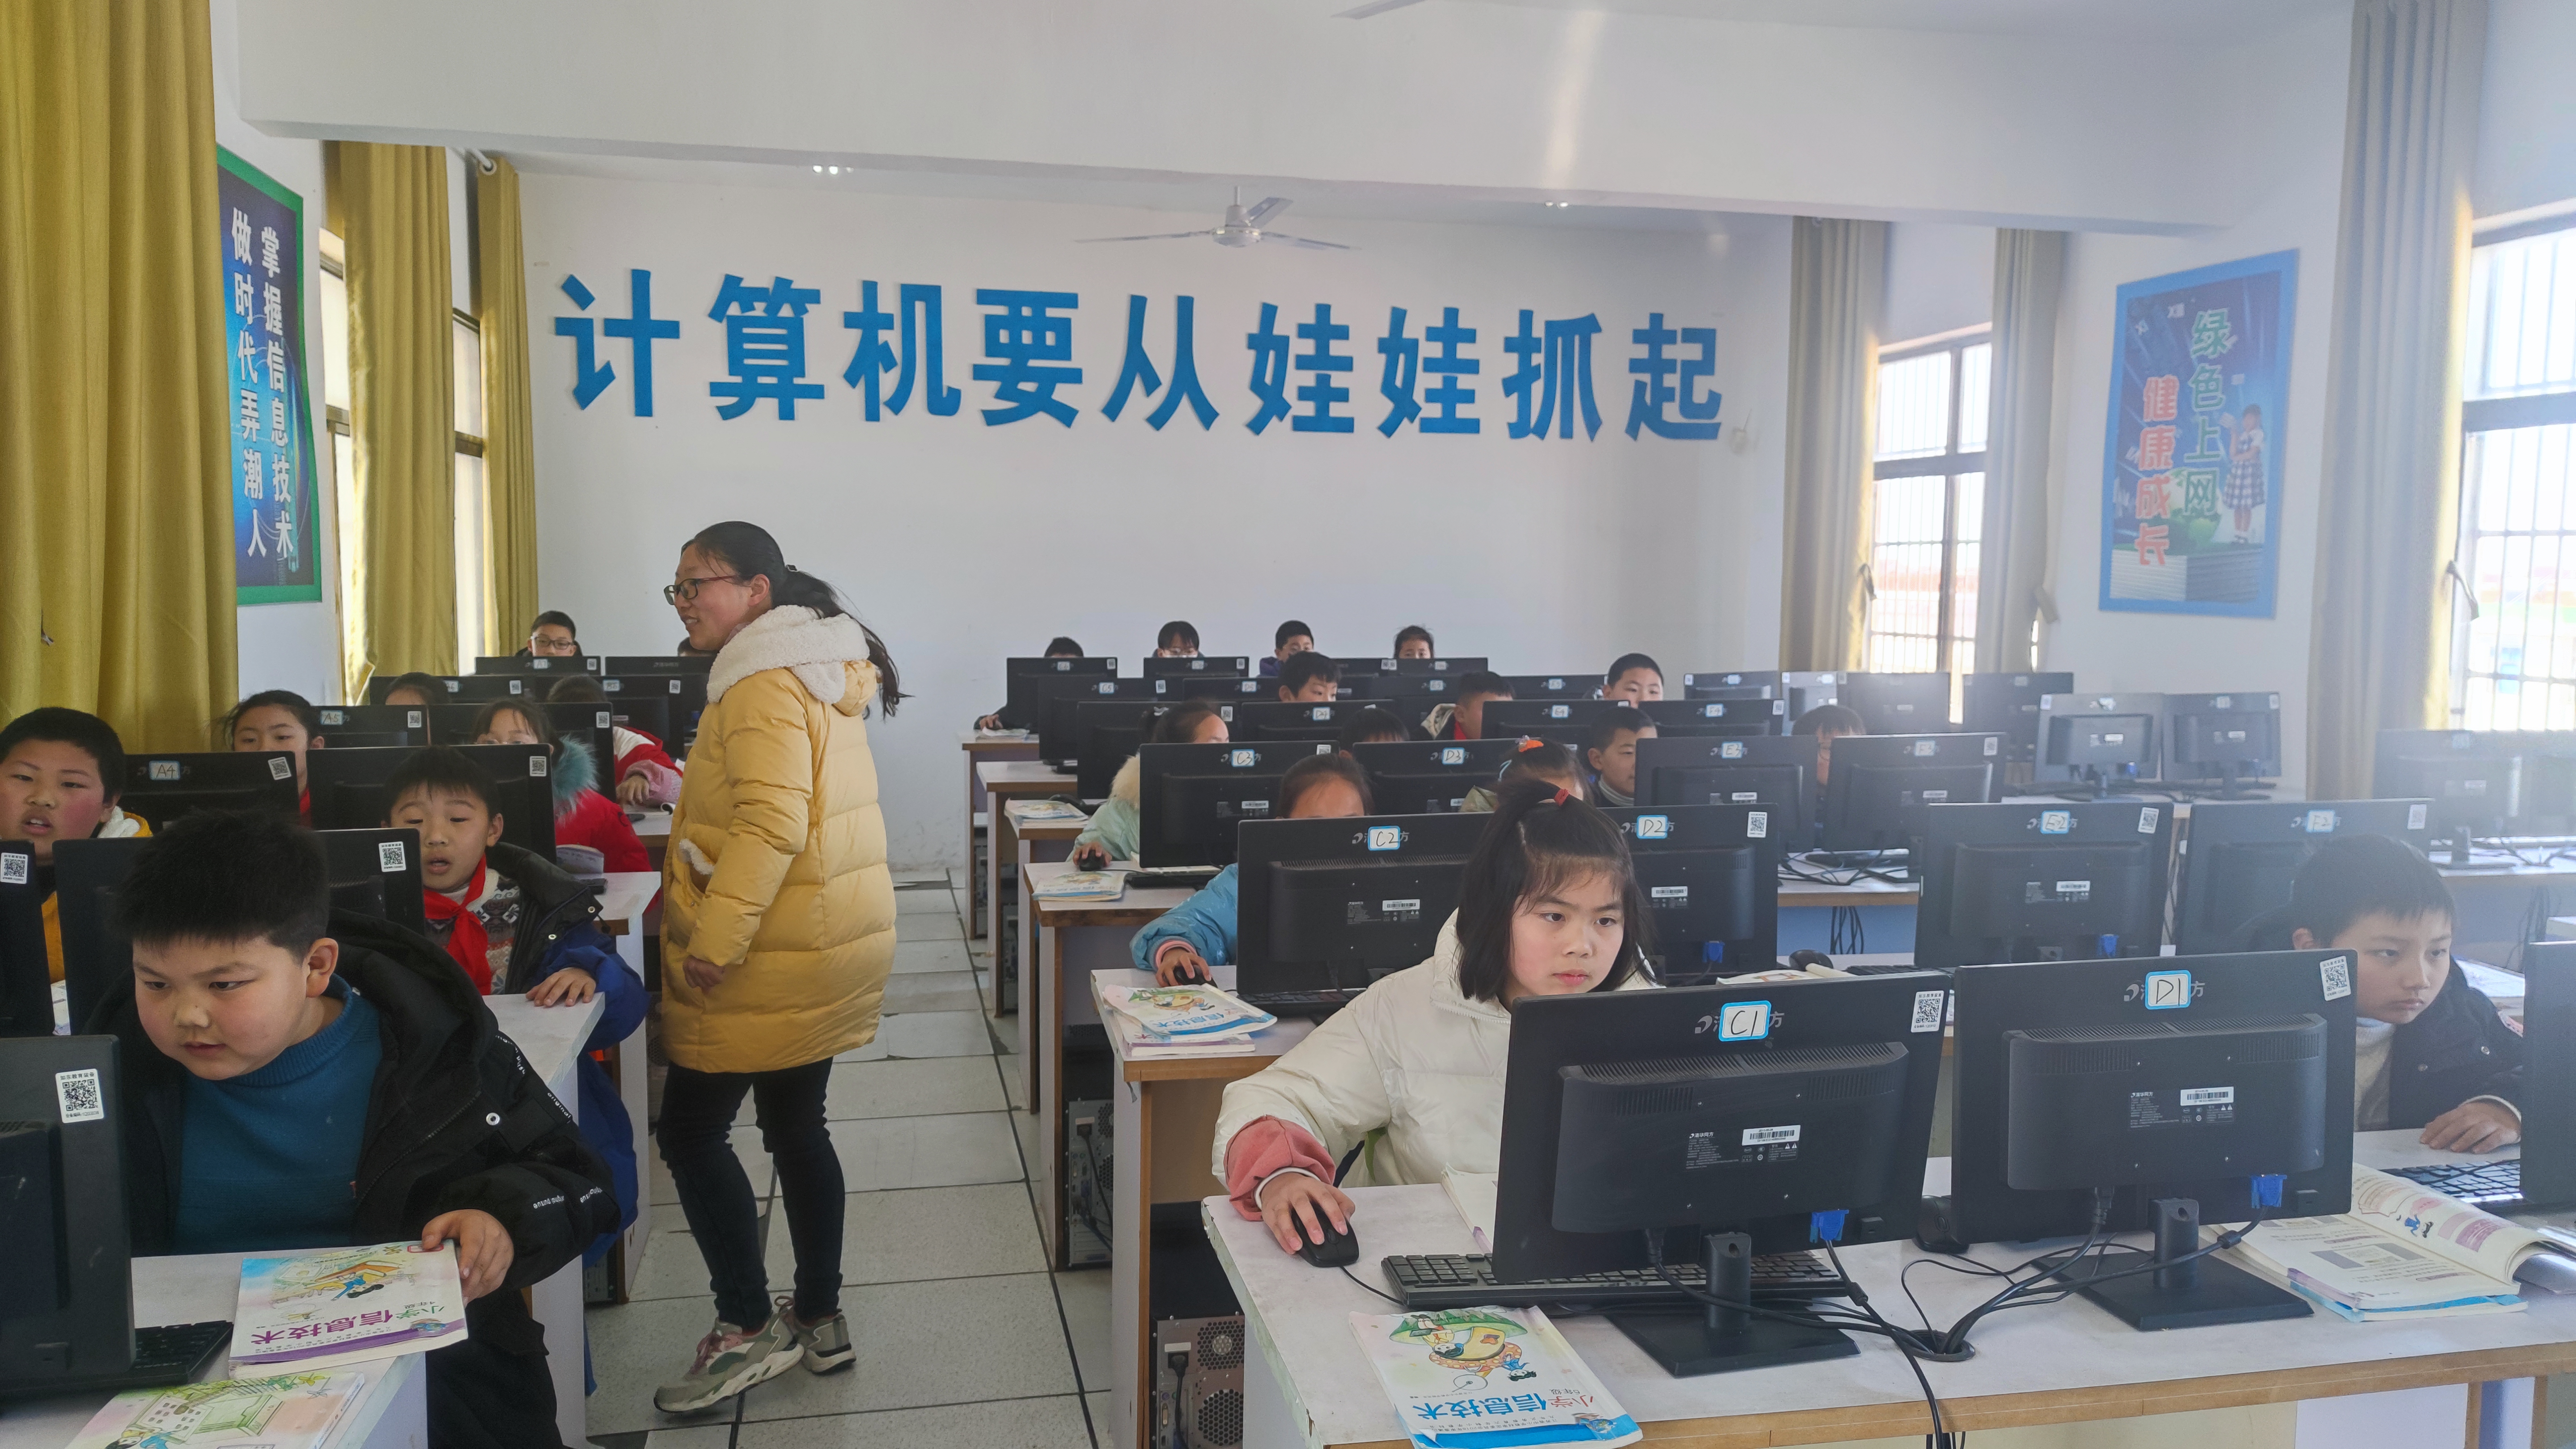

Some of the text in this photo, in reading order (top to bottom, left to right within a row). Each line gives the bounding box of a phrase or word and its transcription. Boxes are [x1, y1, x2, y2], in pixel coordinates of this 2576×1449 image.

[555, 269, 1723, 442] 计算机要从娃娃抓起
[231, 207, 267, 558] 做时代弄潮人
[260, 226, 295, 558] 掌握信息技术
[2183, 308, 2232, 516] 绿色上网
[2135, 374, 2180, 566] 健康成长
[322, 713, 339, 724] A5
[1237, 752, 1253, 765] C3
[1445, 750, 1461, 762] D3
[1726, 744, 1741, 757] E3
[156, 763, 176, 779] A4
[1642, 819, 1667, 837] D2
[2045, 814, 2066, 830] E2
[2312, 815, 2331, 831] F2
[1376, 831, 1400, 847] C2
[2155, 978, 2181, 1007] D1
[1730, 1010, 1758, 1037] C1
[547, 1092, 572, 1119] original
[396, 1305, 445, 1320] 小学
[250, 1309, 393, 1345] 信息技术
[1412, 1393, 1594, 1420] 小学 信息技术
